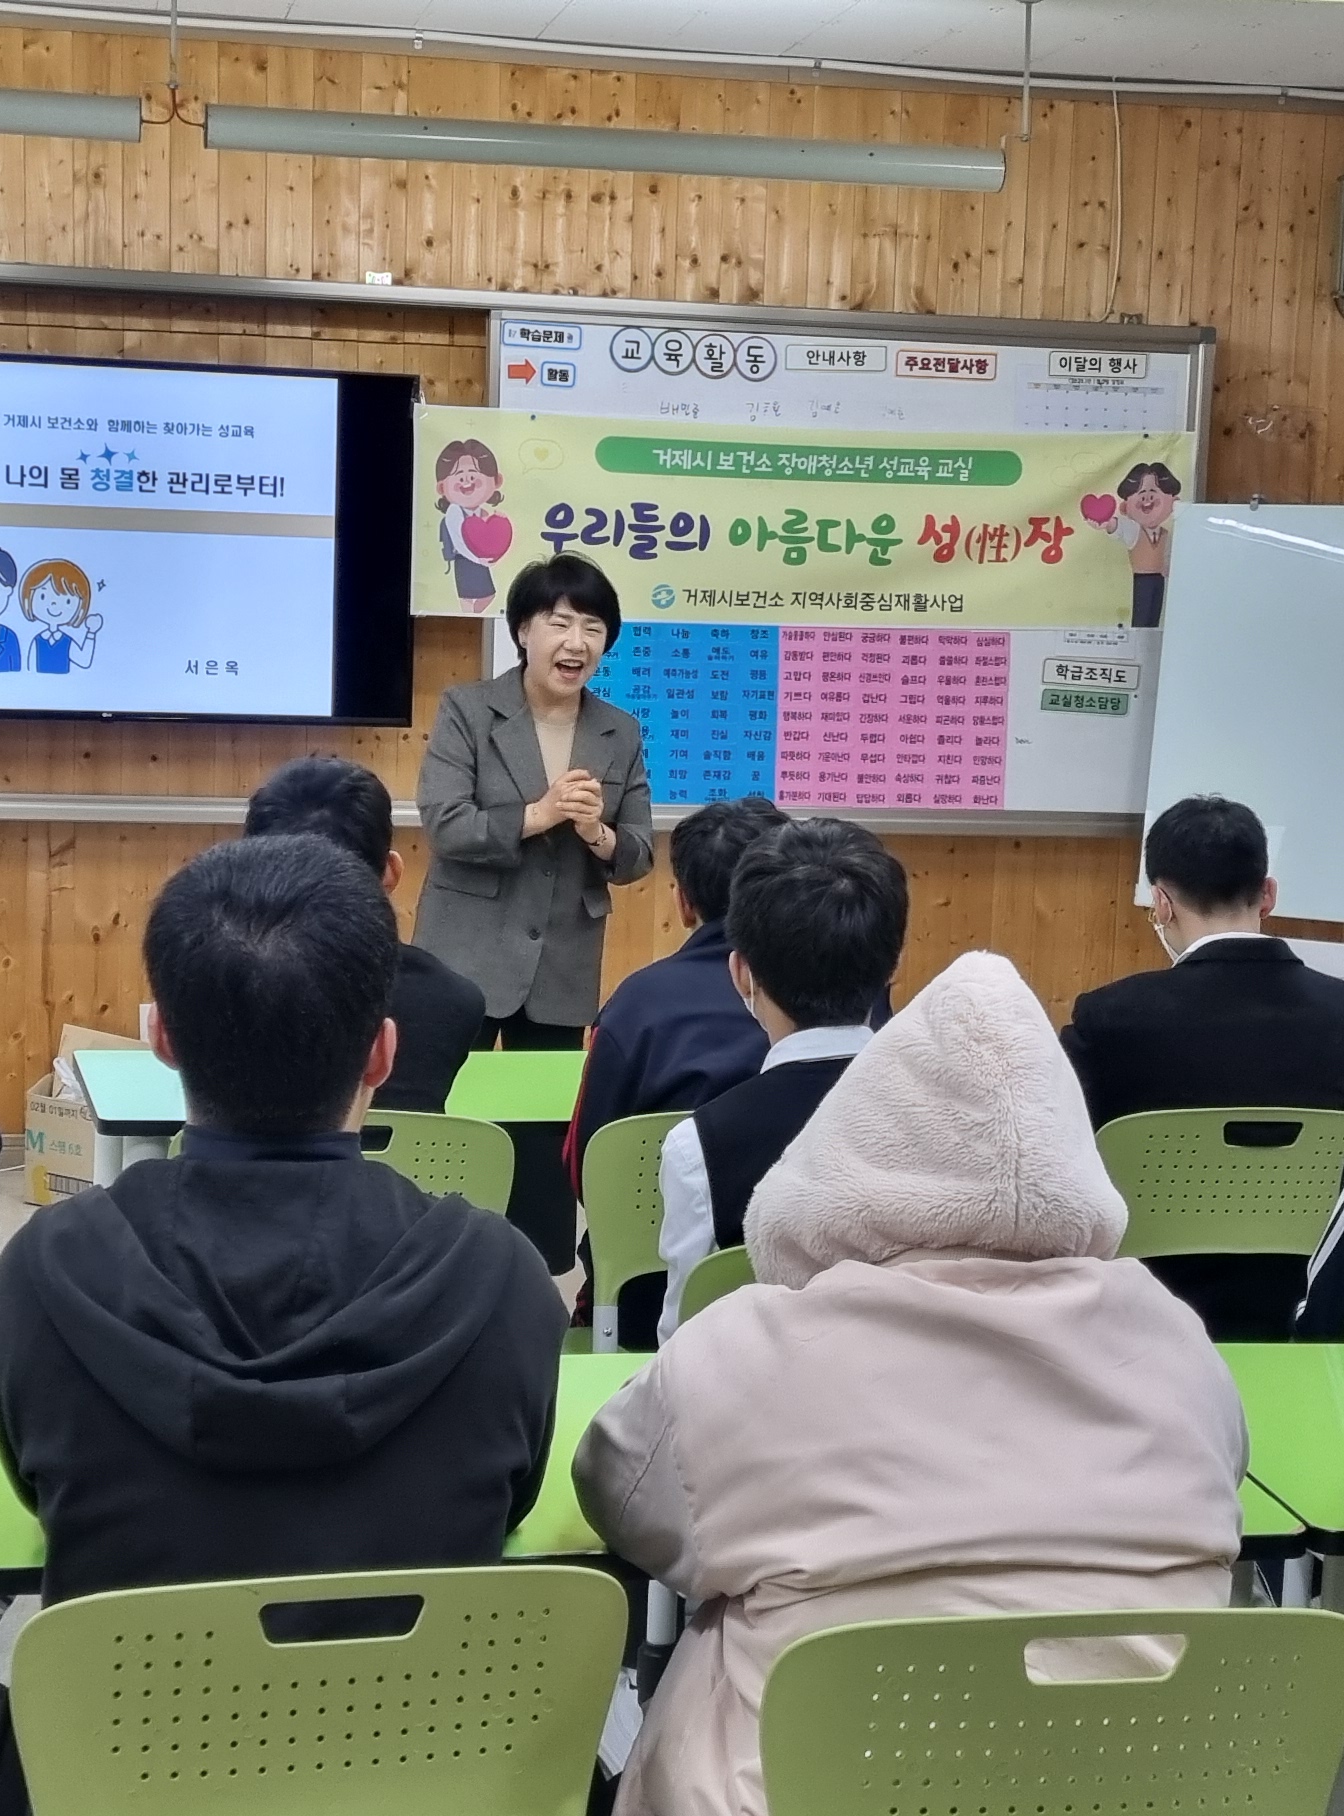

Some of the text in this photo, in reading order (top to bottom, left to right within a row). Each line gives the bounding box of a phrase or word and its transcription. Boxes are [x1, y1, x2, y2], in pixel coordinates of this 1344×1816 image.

[519, 327, 565, 345] 학습문제
[621, 338, 767, 374] 교육활동
[806, 348, 868, 368] 안내사항
[904, 356, 989, 375] 주요전달사항
[1059, 356, 1138, 375] 이달의 행사
[3, 413, 42, 429] 거제시
[47, 415, 99, 432] 보건소와
[107, 418, 158, 435] 함께하는
[162, 421, 213, 437] 찾아가는
[217, 423, 255, 439] 성교육
[652, 447, 973, 482] 거제시 보건소 장애청소년 성교육 교실
[5, 464, 50, 489] 나의
[59, 467, 81, 491] 몸
[90, 467, 158, 493] 청결한
[167, 470, 286, 498] 관리로부터!
[540, 501, 1074, 567] 우리들의 아름다운 성(性)장
[682, 587, 965, 614] 거제시보건소 지역사회중심재활사업
[783, 672, 812, 682] 고맙다
[900, 674, 926, 685] 슬프다
[1055, 663, 1128, 683] 학급조직도
[784, 692, 812, 702] 기쁘다
[1048, 693, 1121, 711] 교실청소담당
[783, 730, 810, 741] 반갑다
[822, 732, 848, 742] 신난다
[860, 753, 886, 764] 무섭다
[26, 1128, 45, 1154] M
